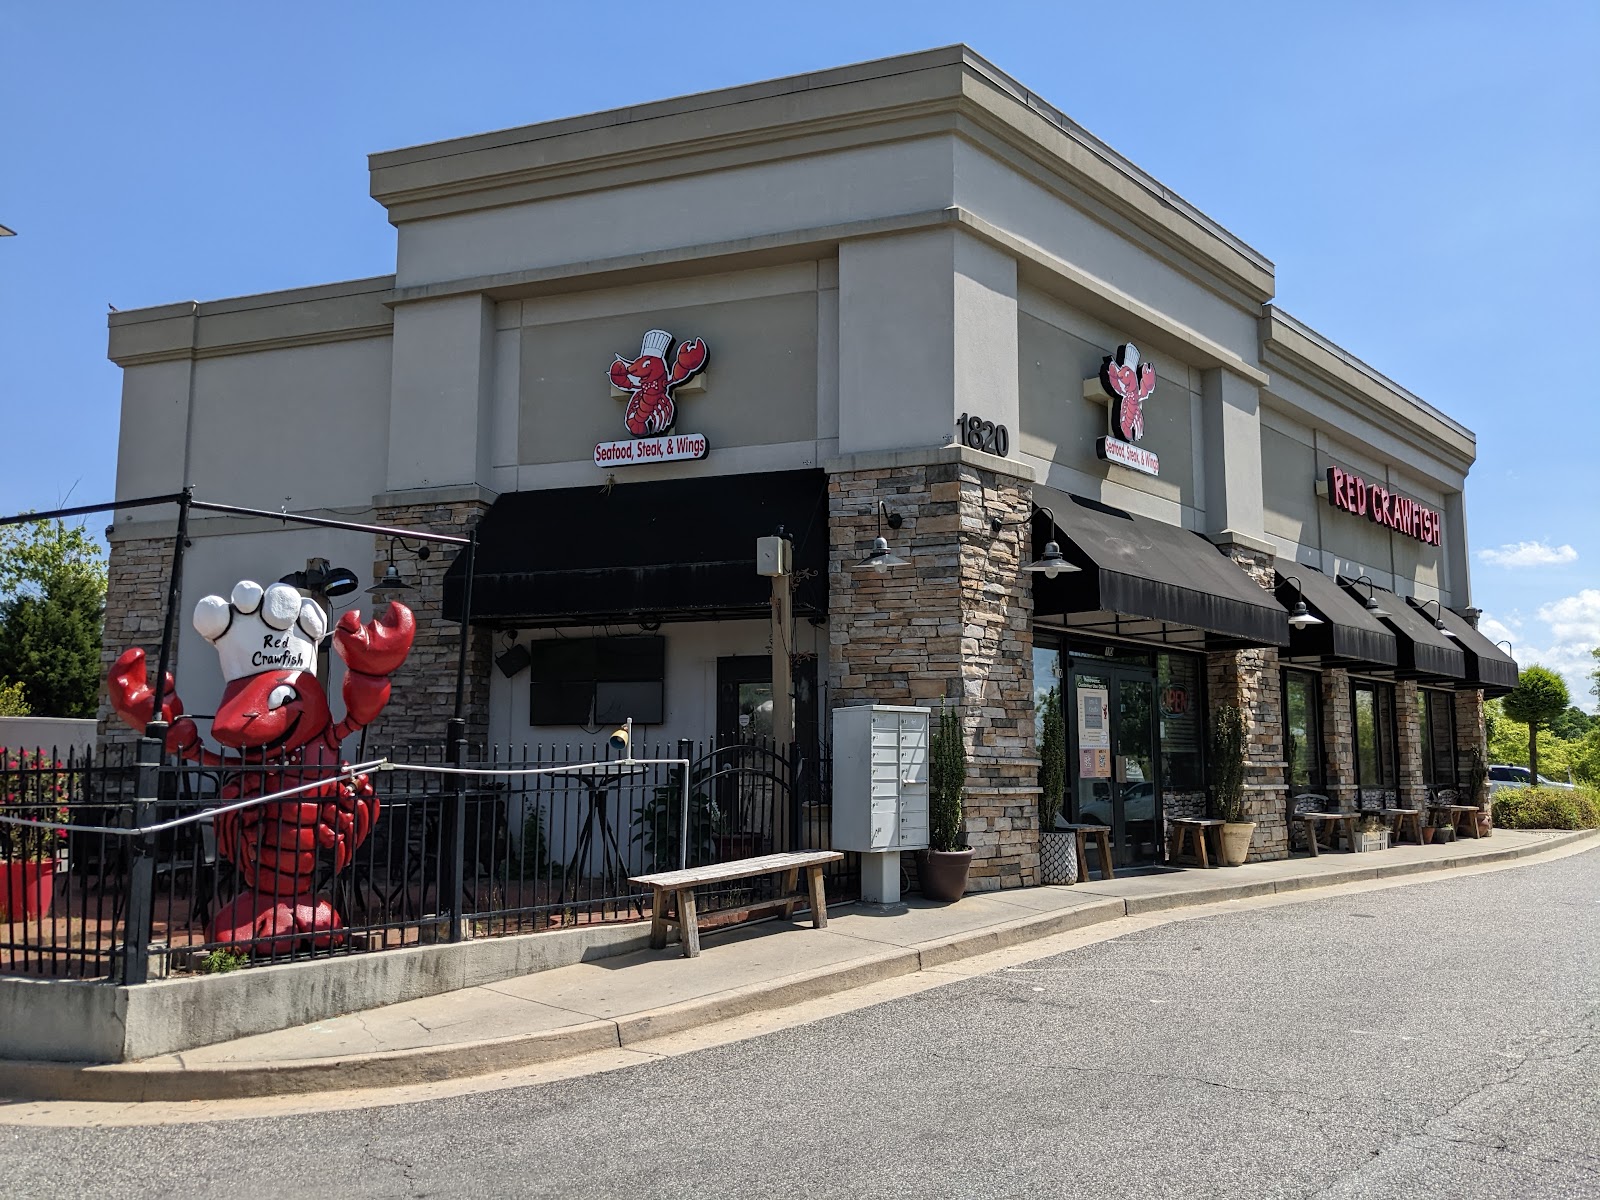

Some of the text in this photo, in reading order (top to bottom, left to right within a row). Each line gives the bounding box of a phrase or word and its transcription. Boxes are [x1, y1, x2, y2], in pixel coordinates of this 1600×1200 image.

[956, 412, 1009, 457] 1820
[595, 437, 705, 461] Seafood, Steak, & Wings
[1145, 452, 1159, 473] Wings
[1331, 466, 1441, 546] RED CRAWFISH
[263, 634, 290, 649] Red
[251, 649, 304, 667] Crawfish
